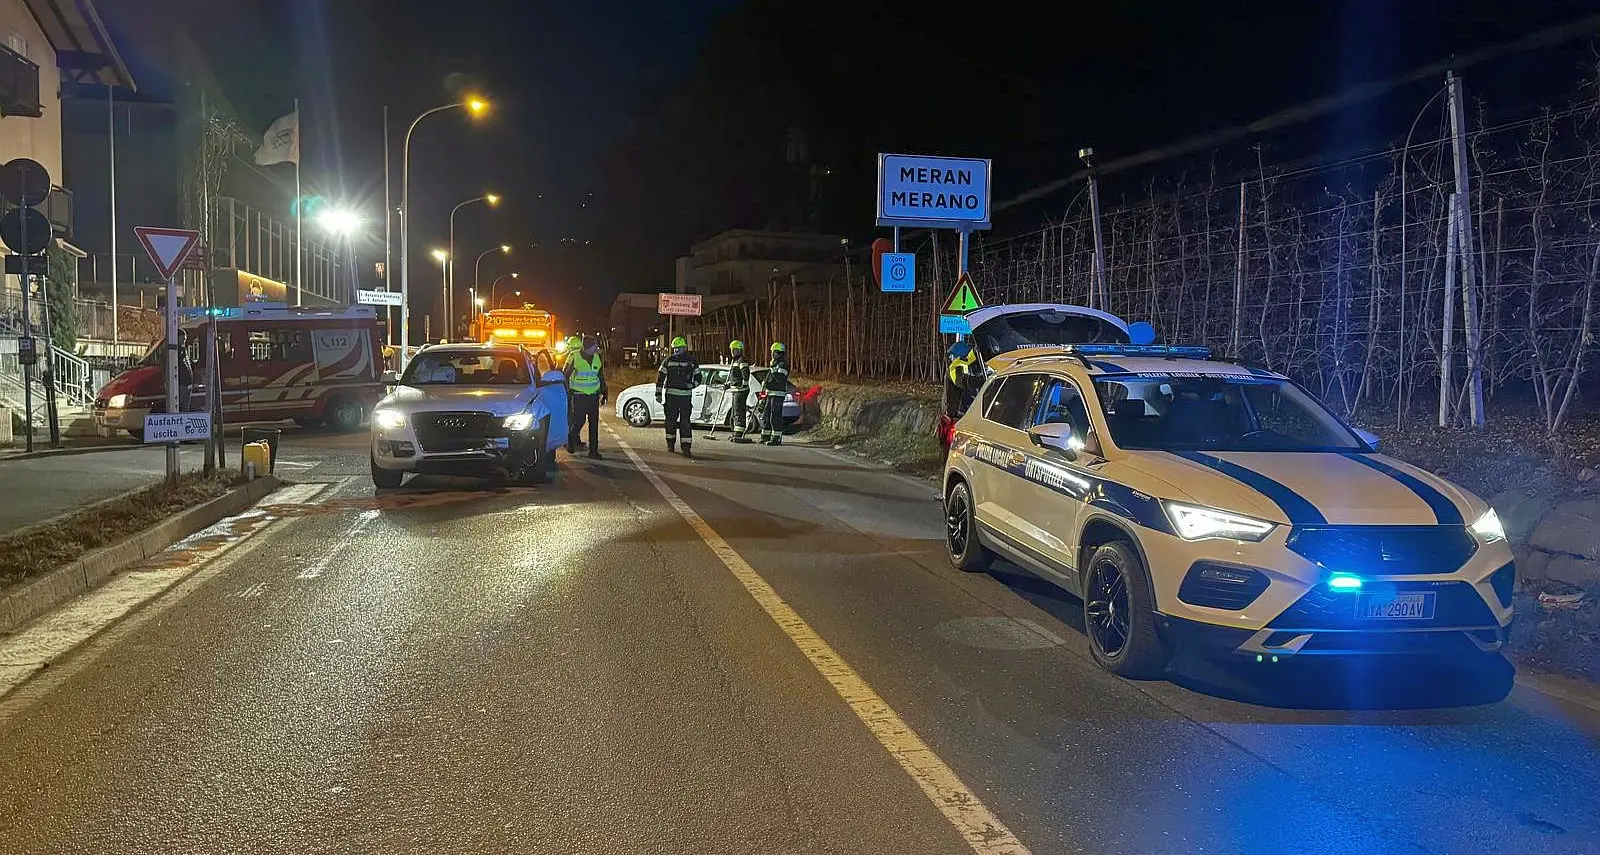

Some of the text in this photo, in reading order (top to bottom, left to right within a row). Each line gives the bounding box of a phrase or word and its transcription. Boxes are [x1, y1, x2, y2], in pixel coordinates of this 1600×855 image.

[900, 166, 971, 186] MERAN
[891, 191, 979, 210] MERANO
[893, 267, 904, 277] 40
[485, 316, 501, 326] 210
[331, 337, 347, 346] 112
[147, 416, 183, 427] Ausfahrt
[153, 428, 178, 439] uscita
